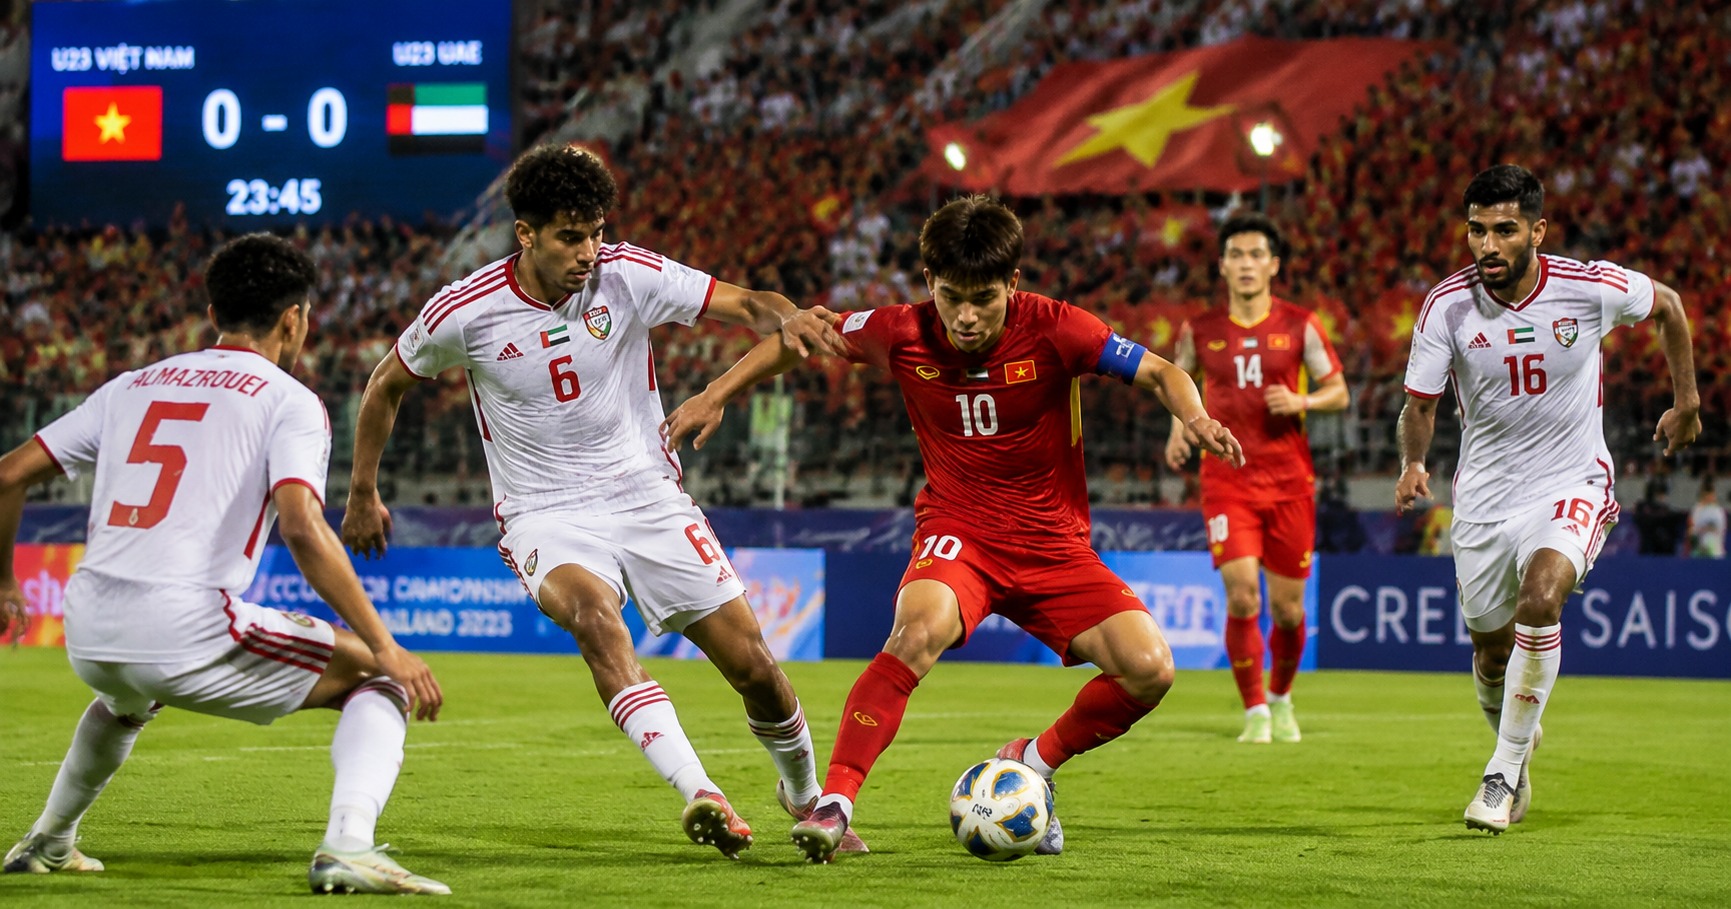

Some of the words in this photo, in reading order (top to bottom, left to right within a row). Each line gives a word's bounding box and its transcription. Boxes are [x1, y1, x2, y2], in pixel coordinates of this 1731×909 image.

[51, 46, 93, 72] U23
[94, 42, 144, 75] VIỆT
[144, 45, 196, 70] NAM
[392, 41, 436, 66] U23
[437, 40, 483, 65] UAE
[202, 88, 242, 150] 0
[307, 87, 348, 148] 0
[226, 178, 322, 215] 23:45
[127, 367, 269, 397] ALMAZROUEI
[548, 354, 582, 403] 6
[1233, 353, 1264, 390] 14
[1503, 353, 1548, 396] 16
[955, 393, 999, 437] 10
[107, 401, 211, 529] 5
[1551, 498, 1594, 529] 16
[684, 523, 721, 565] 6
[918, 534, 963, 561] 10
[1580, 588, 1731, 650] SAIS
